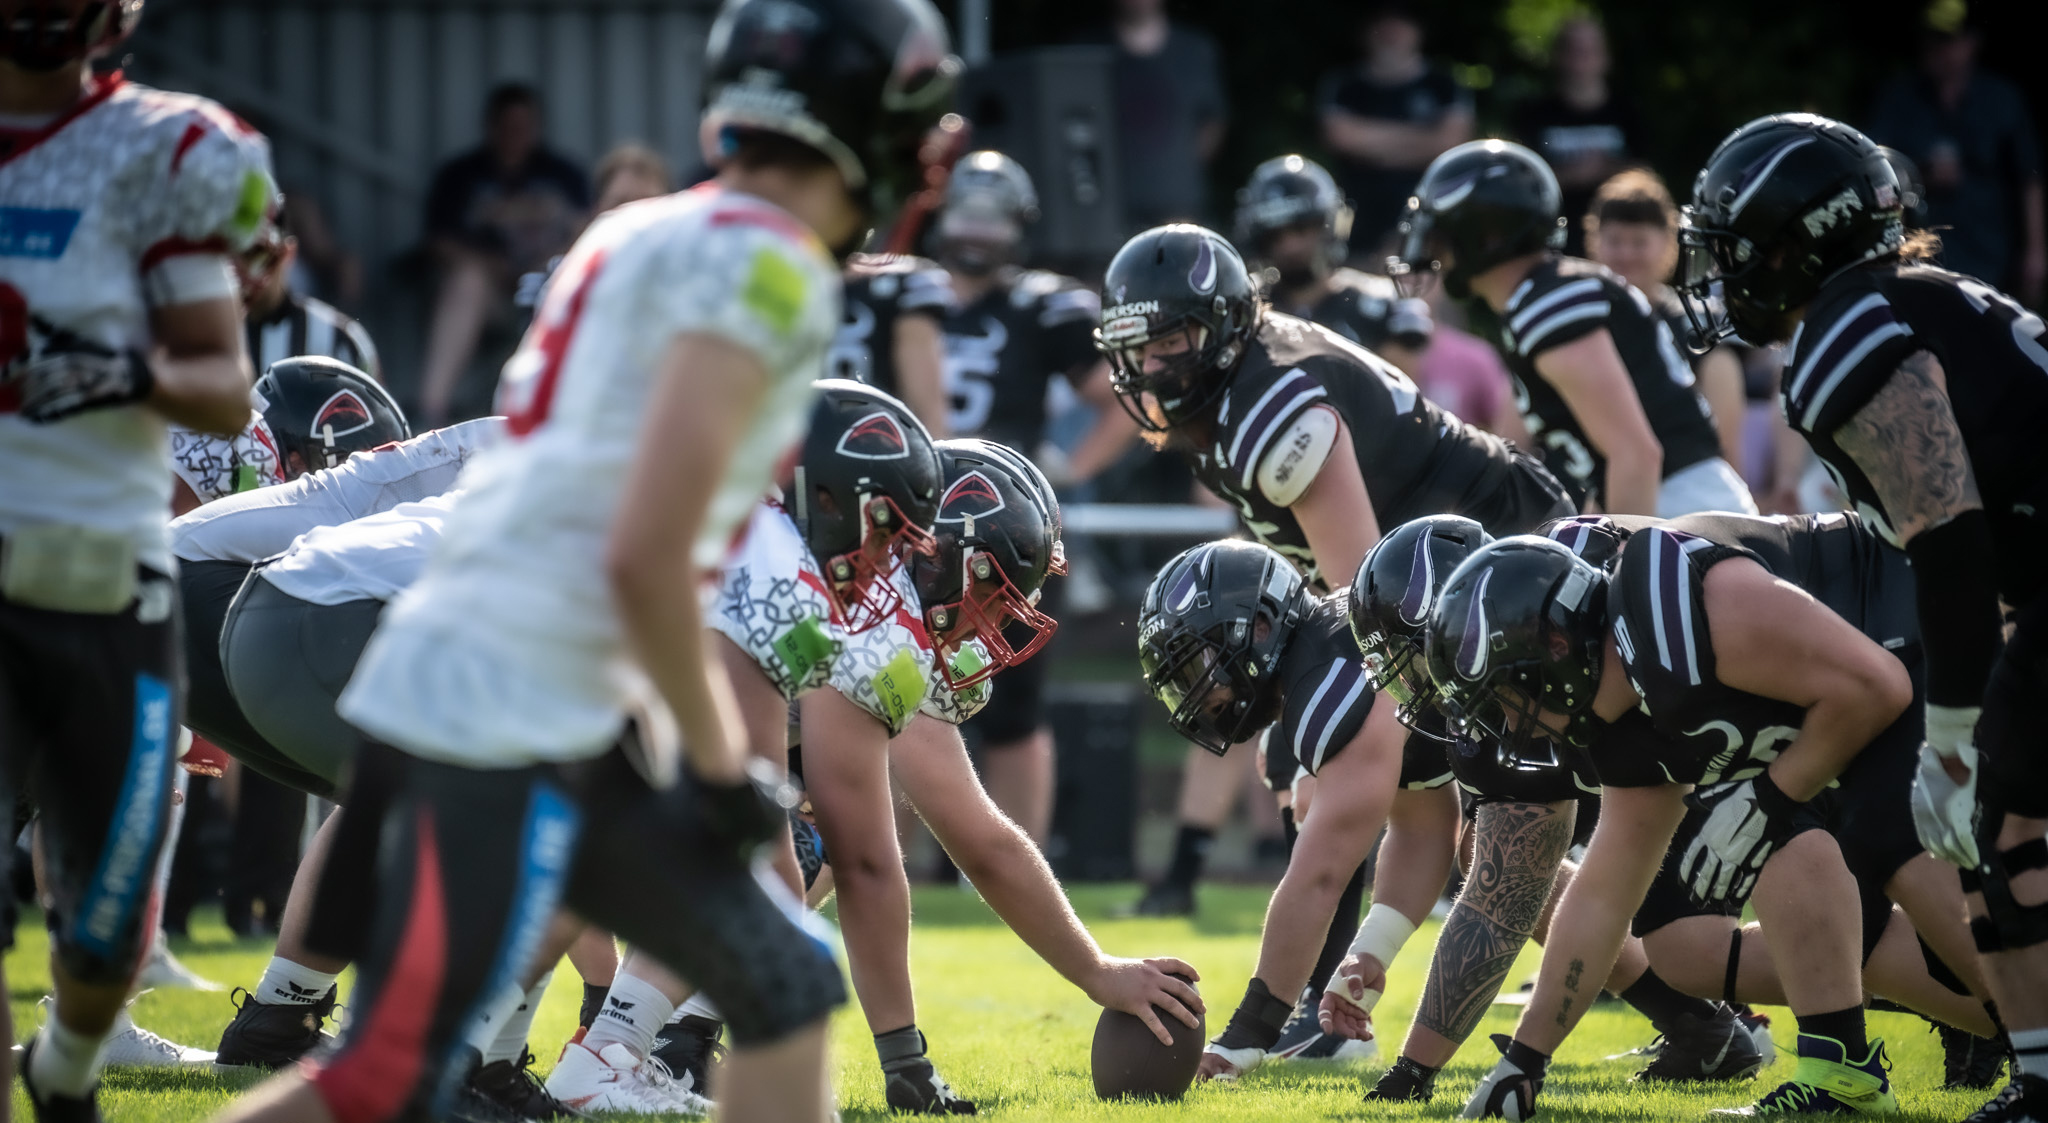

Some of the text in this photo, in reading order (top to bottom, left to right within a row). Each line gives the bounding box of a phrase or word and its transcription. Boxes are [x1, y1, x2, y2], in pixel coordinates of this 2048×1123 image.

[880, 671, 907, 717] 12-05
[951, 664, 979, 698] 1205
[600, 1008, 635, 1025] erima
